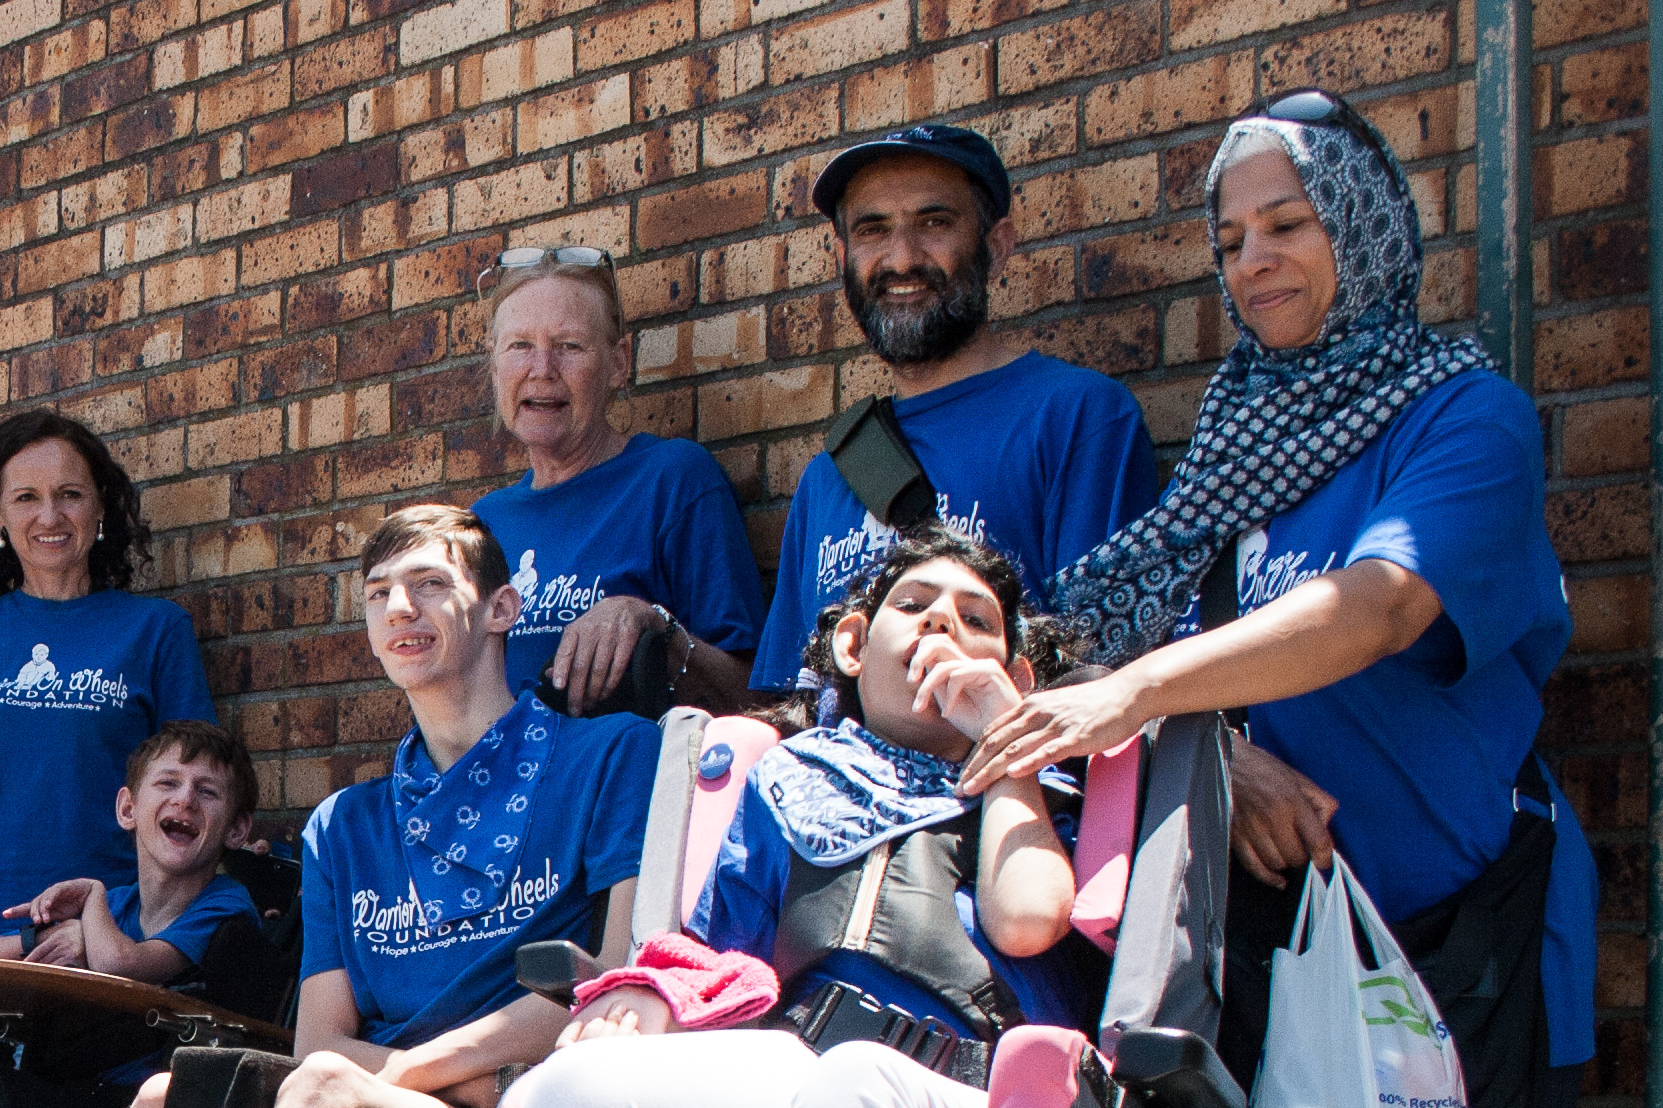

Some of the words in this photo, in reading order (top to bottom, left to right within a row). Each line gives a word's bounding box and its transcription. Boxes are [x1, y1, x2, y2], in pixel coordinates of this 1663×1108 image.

[37, 671, 64, 692] On
[70, 668, 128, 700] Wheels
[6, 697, 43, 710] Courage
[51, 701, 95, 711] Adventure
[352, 888, 417, 931] Warrior
[353, 906, 535, 943] FOUNDATIO
[380, 945, 409, 958] Hope
[418, 934, 458, 952] Courage
